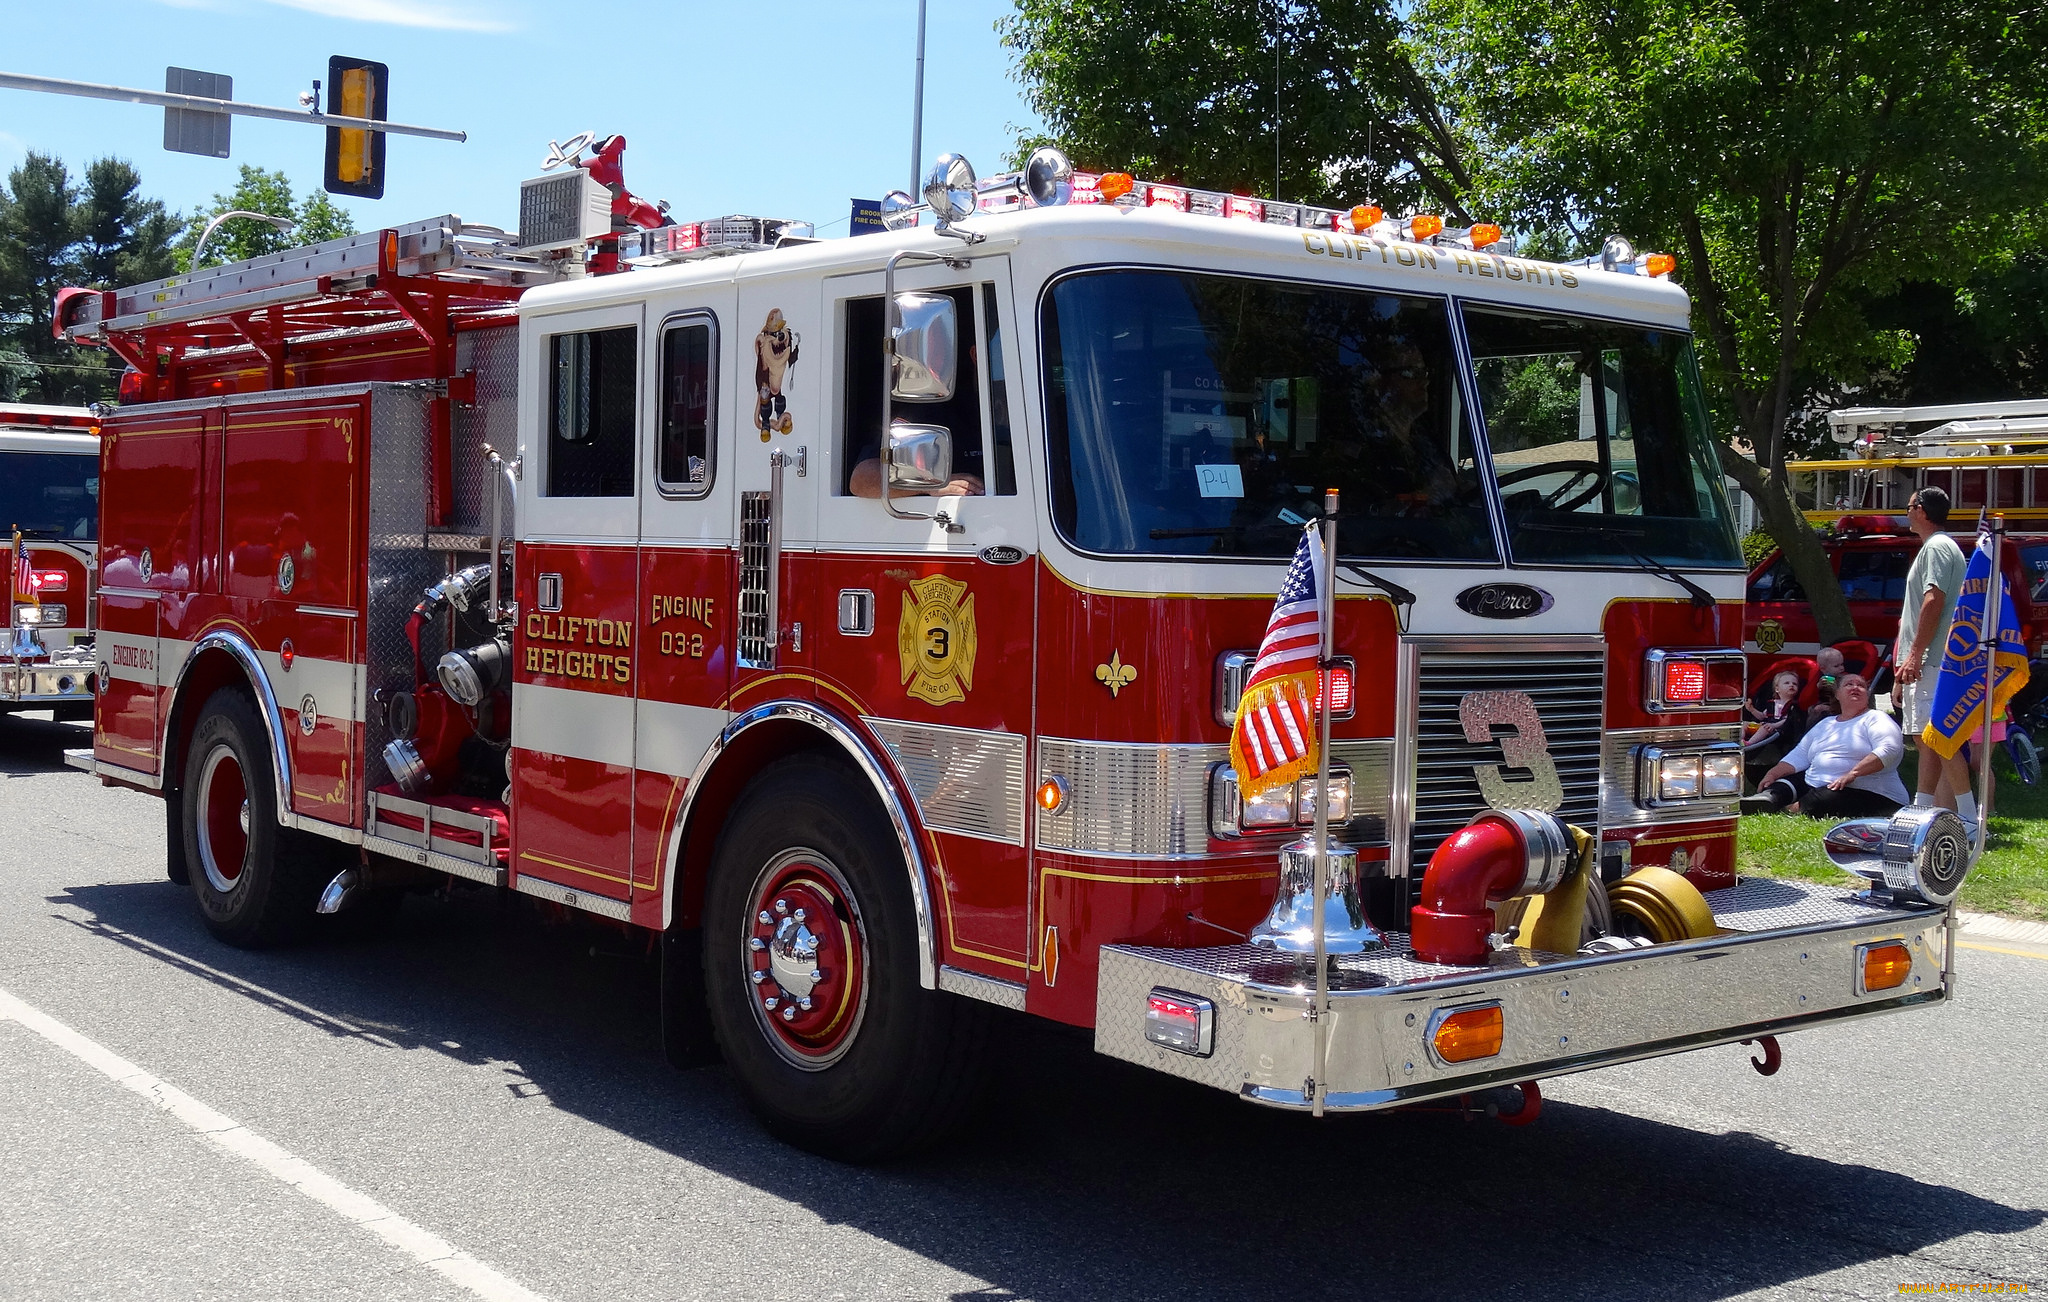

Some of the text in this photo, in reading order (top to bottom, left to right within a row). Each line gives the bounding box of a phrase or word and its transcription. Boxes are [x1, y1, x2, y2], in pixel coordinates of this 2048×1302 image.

[1301, 232, 1579, 289] CLIFTON HEIGHTS
[1194, 376, 1210, 389] CO
[985, 546, 1018, 560] Lance
[922, 582, 954, 596] CLIFTON
[923, 591, 952, 603] HEIGHTS
[1476, 587, 1533, 614] Pierce
[652, 594, 714, 629] ENGINE
[924, 609, 951, 625] STATION
[526, 614, 632, 648] CLIFTON
[926, 627, 949, 659] 3
[1764, 630, 1776, 642] 20
[1950, 632, 1974, 652] 1
[113, 644, 154, 670] ENGINE 03-2
[526, 647, 631, 683] HEIGHTS
[921, 679, 950, 694] FIRE CO
[1943, 680, 1986, 729] CLIFTON
[1458, 689, 1564, 813] 3
